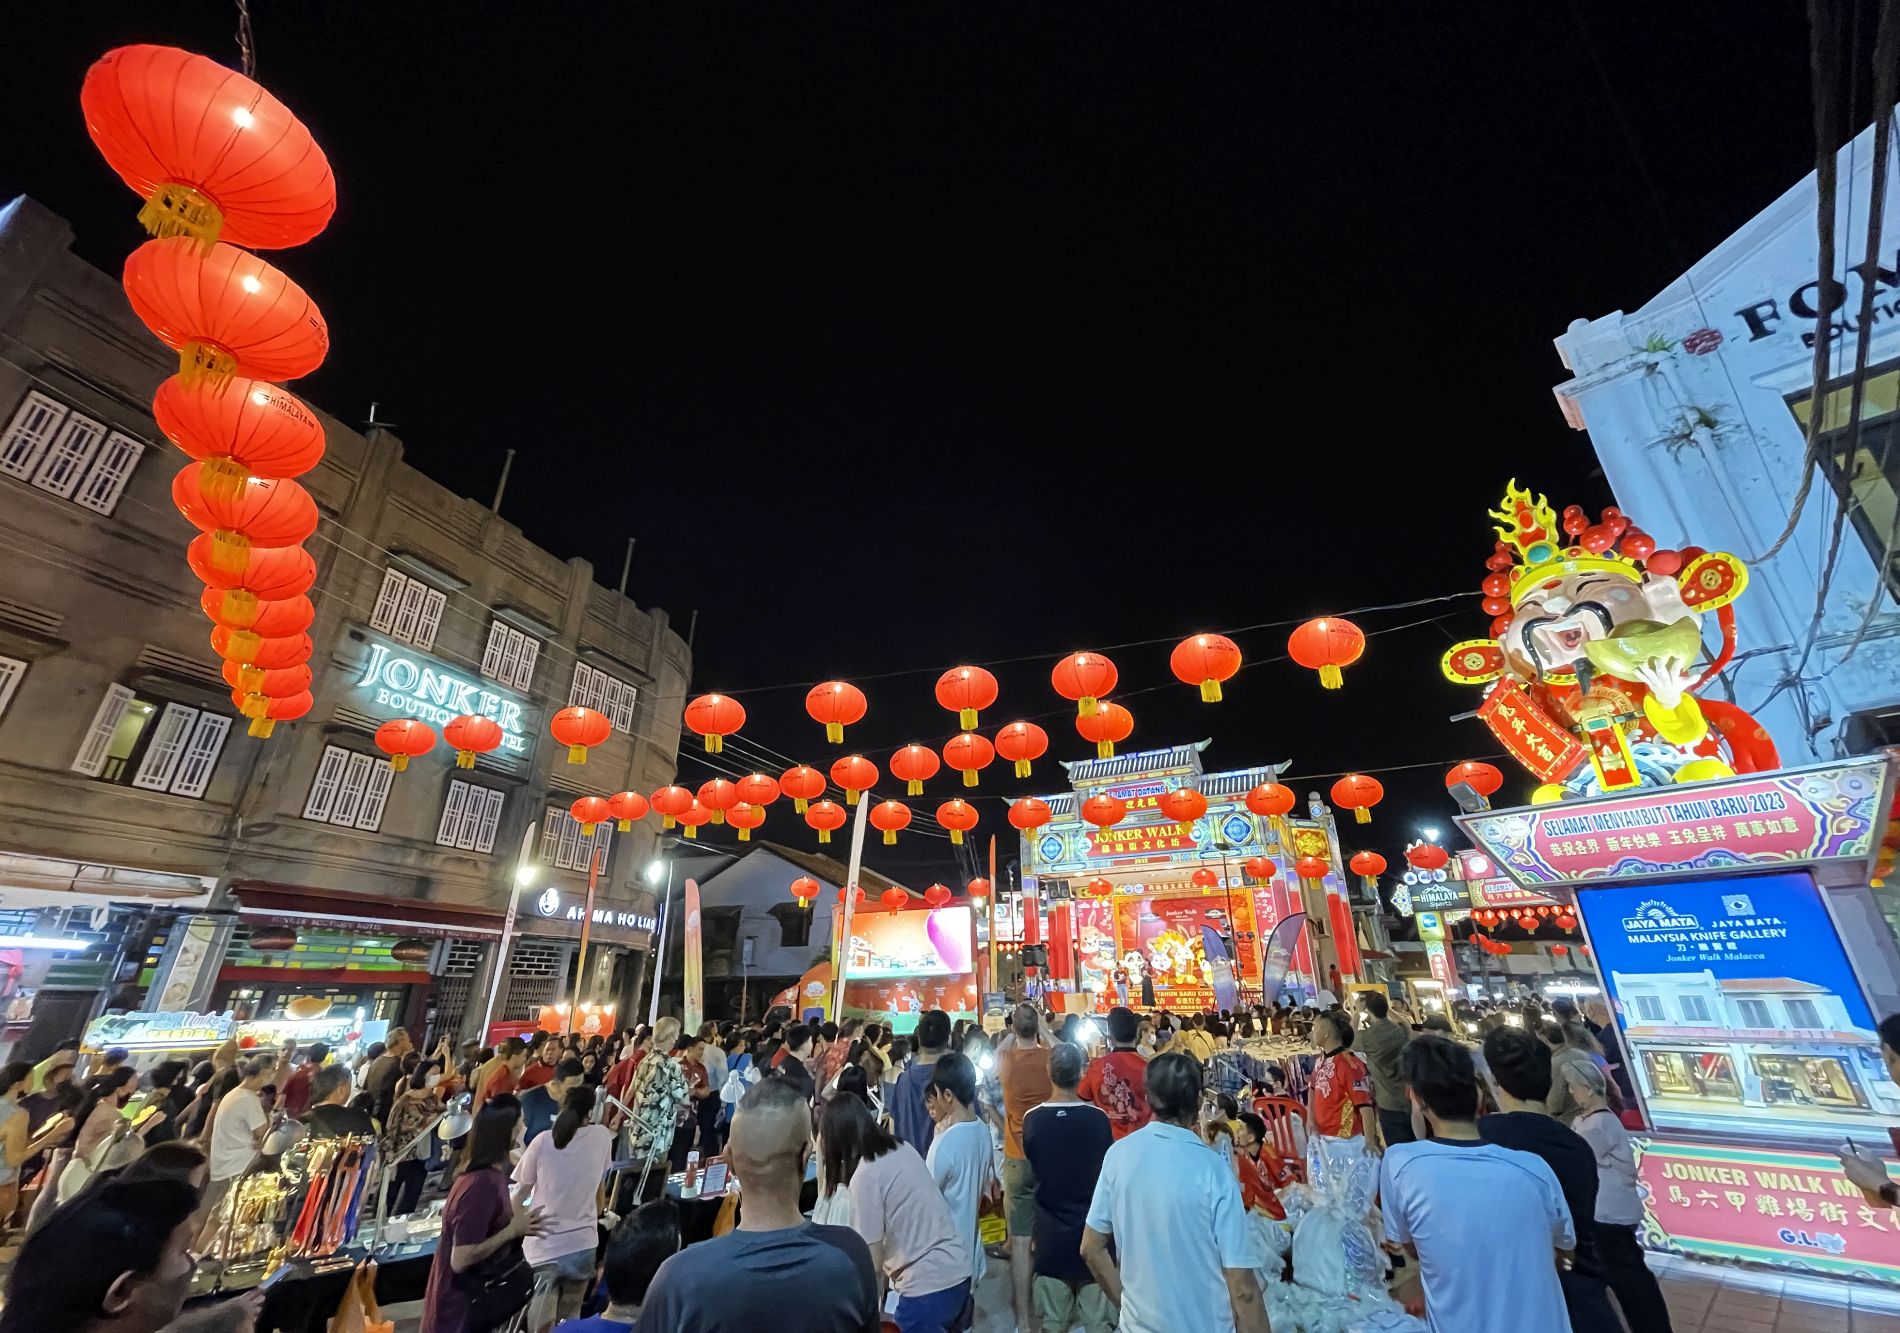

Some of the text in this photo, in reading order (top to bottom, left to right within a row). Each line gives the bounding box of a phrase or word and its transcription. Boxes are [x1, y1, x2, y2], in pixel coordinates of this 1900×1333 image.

[270, 396, 308, 425] HIMALAYA
[356, 643, 522, 734] JONKER
[1542, 791, 1786, 838] SELAMAT MENYAMBUT TAHUN BARU 2023
[1094, 824, 1184, 844] JONKER WALK
[1550, 838, 1600, 857] 恭祝各界
[1605, 831, 1662, 851] 新年快樂
[1733, 816, 1800, 838] 萬事如意
[1419, 891, 1459, 902] HIMALAYA
[1429, 901, 1453, 909] Sports
[592, 909, 613, 924] MA
[617, 913, 636, 927] HO
[1626, 917, 1696, 930] JAYA MATA
[1711, 920, 1743, 928] JAYA
[1628, 928, 1788, 944] MALAYSIA KNIFE GALLERY
[1666, 952, 1766, 962] Jonker Walk Malacca
[1661, 1162, 1750, 1187] JONKER
[1754, 1170, 1828, 1195] WALK
